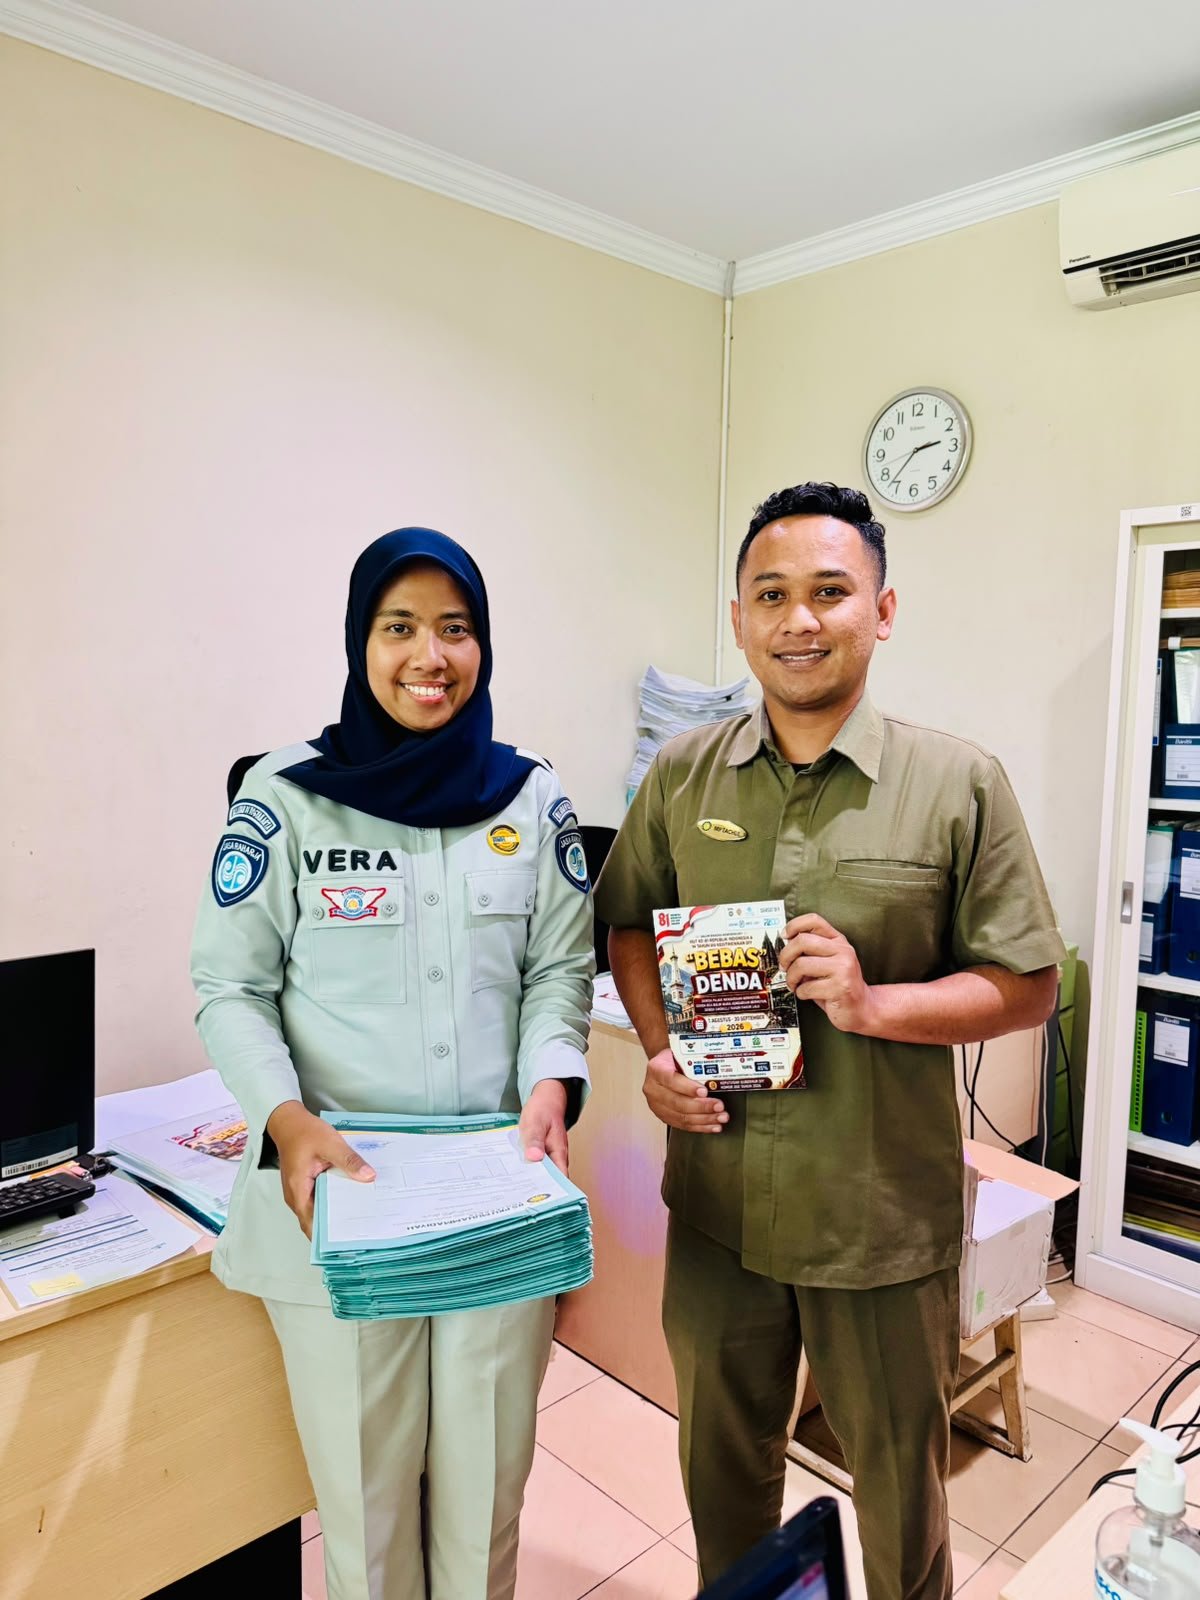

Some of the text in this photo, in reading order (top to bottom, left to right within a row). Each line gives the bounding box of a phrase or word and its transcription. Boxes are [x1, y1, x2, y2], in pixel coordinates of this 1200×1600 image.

[912, 402, 924, 417] 12
[934, 404, 938, 419] 1
[897, 411, 904, 425] 11
[944, 417, 954, 432] 2
[884, 427, 895, 442] 10
[948, 438, 959, 453] 3
[876, 448, 886, 463] 9
[942, 459, 952, 472] 4
[881, 467, 890, 481] 8
[892, 480, 902, 495] 7
[927, 475, 938, 490] 5
[909, 483, 919, 498] 6
[303, 848, 397, 874] VERA
[658, 912, 669, 927] 81
[695, 972, 763, 994] DENDA
[726, 1023, 744, 1031] 2026
